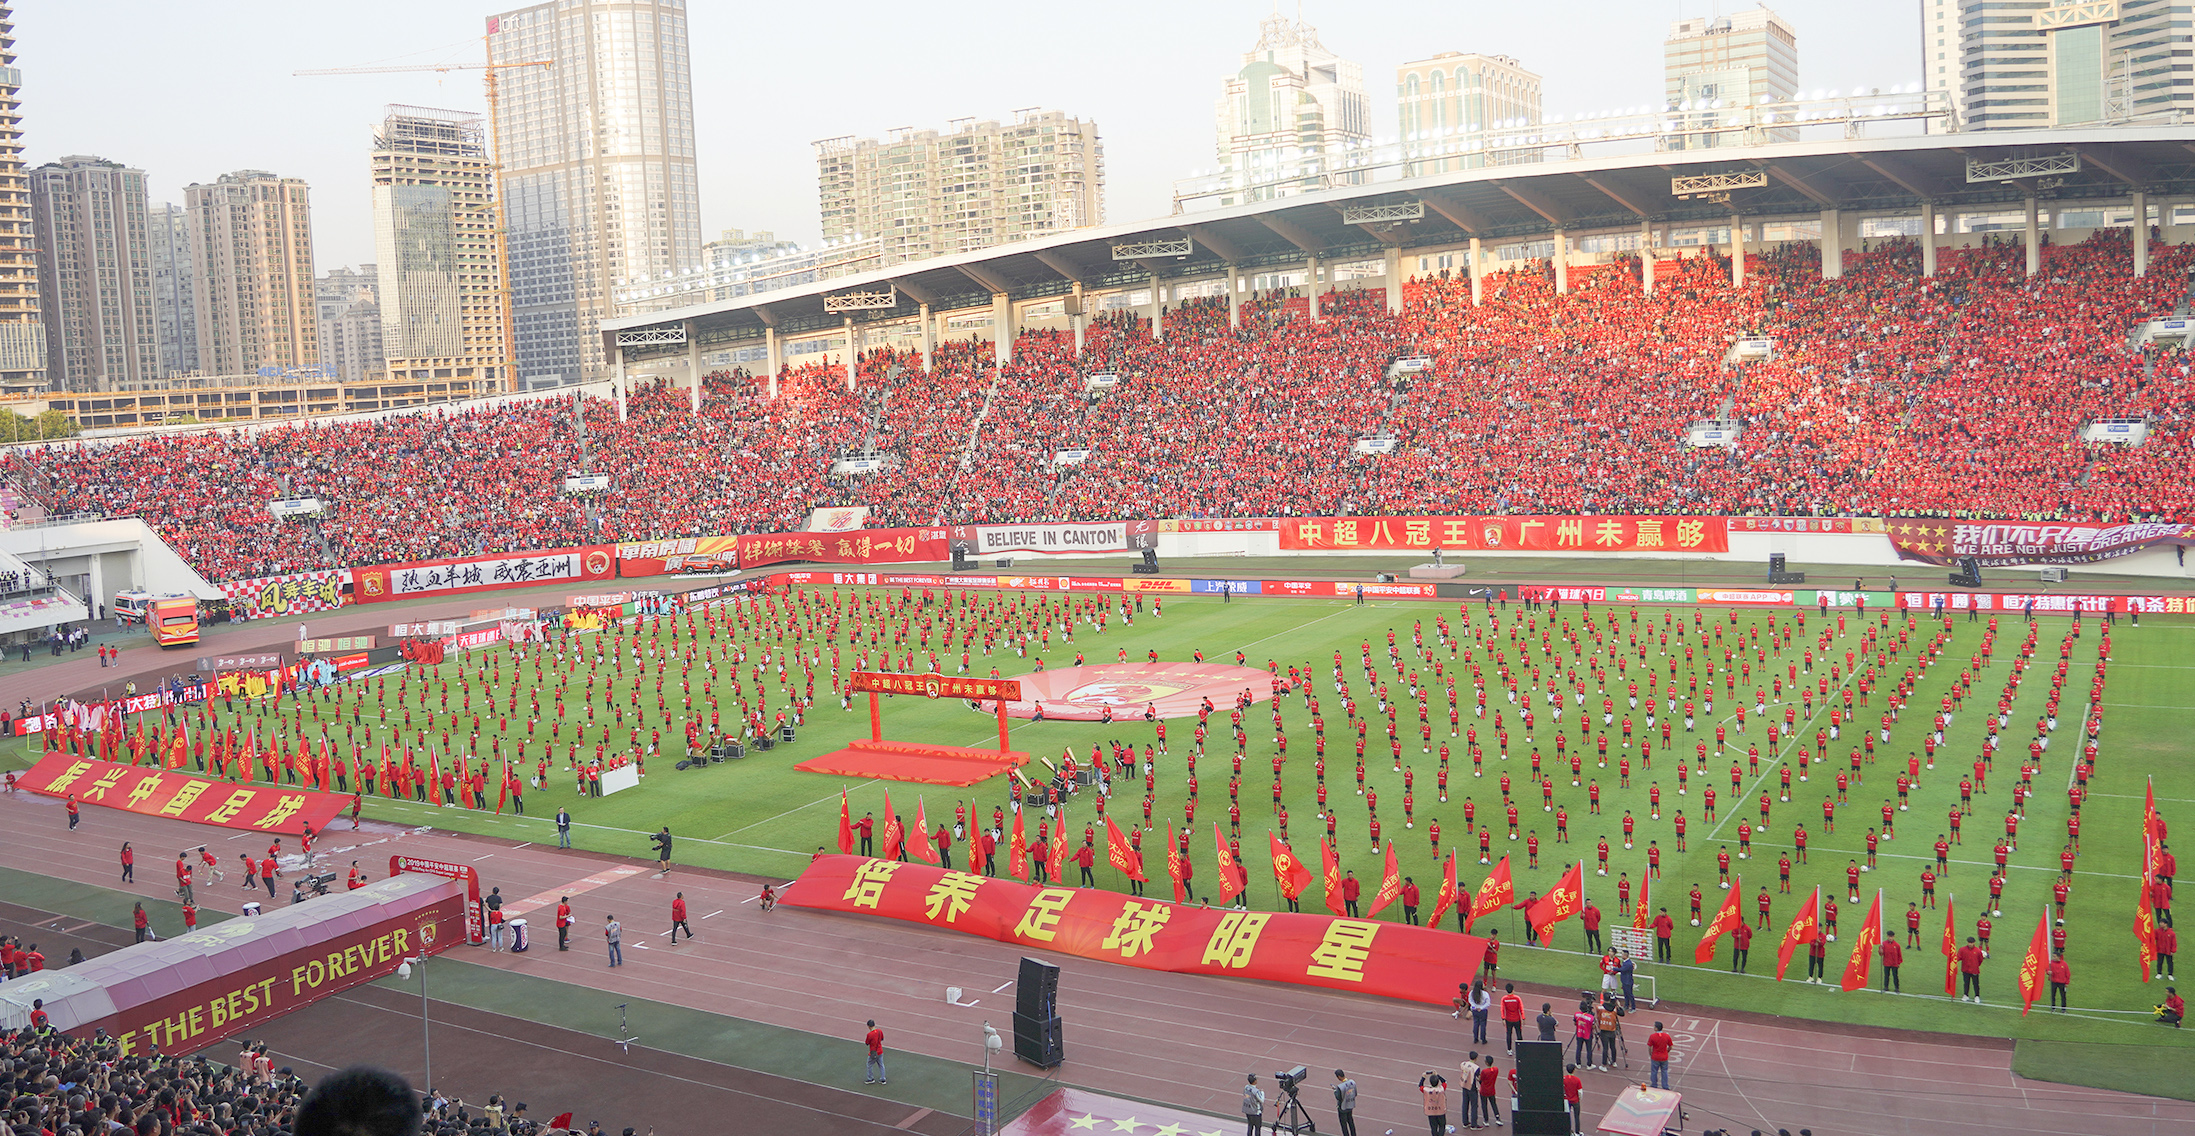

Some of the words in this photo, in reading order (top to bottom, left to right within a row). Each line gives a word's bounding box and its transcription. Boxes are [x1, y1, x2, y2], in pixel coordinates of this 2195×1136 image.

[986, 531, 1037, 547] BELIEVE
[1043, 531, 1057, 545] IN
[1063, 529, 1117, 545] CANTON
[1298, 520, 1468, 546] 中超八冠王
[1518, 519, 1705, 547] 广州未赢够
[1953, 544, 1978, 554] WE
[1980, 543, 2014, 554] ARE
[2016, 544, 2046, 554] NOT
[2049, 542, 2087, 553] JUST
[2089, 527, 2183, 551] DREAMERS
[401, 567, 484, 592] 热血羊城
[493, 555, 571, 583] 威震亚洲
[834, 573, 878, 585] 恒大集团
[260, 573, 339, 614] 凤舞羊城
[1139, 581, 1174, 589] DHL
[574, 594, 625, 606] 中国平安
[1642, 589, 1687, 601] 青岛啤酒
[394, 622, 455, 636] 恒大集团
[301, 639, 332, 652] 恒驰
[338, 636, 368, 650] 恒驰
[871, 678, 925, 691] 中超八冠王
[941, 683, 998, 696] 广州未赢够
[45, 760, 306, 829] 振兴中国足球
[842, 858, 1379, 983] 培养足球明星
[119, 1030, 138, 1058] E
[143, 1005, 206, 1048] THE
[210, 976, 276, 1028] BEST
[291, 927, 411, 997] FOREVER
[1673, 1033, 1696, 1048] 2
